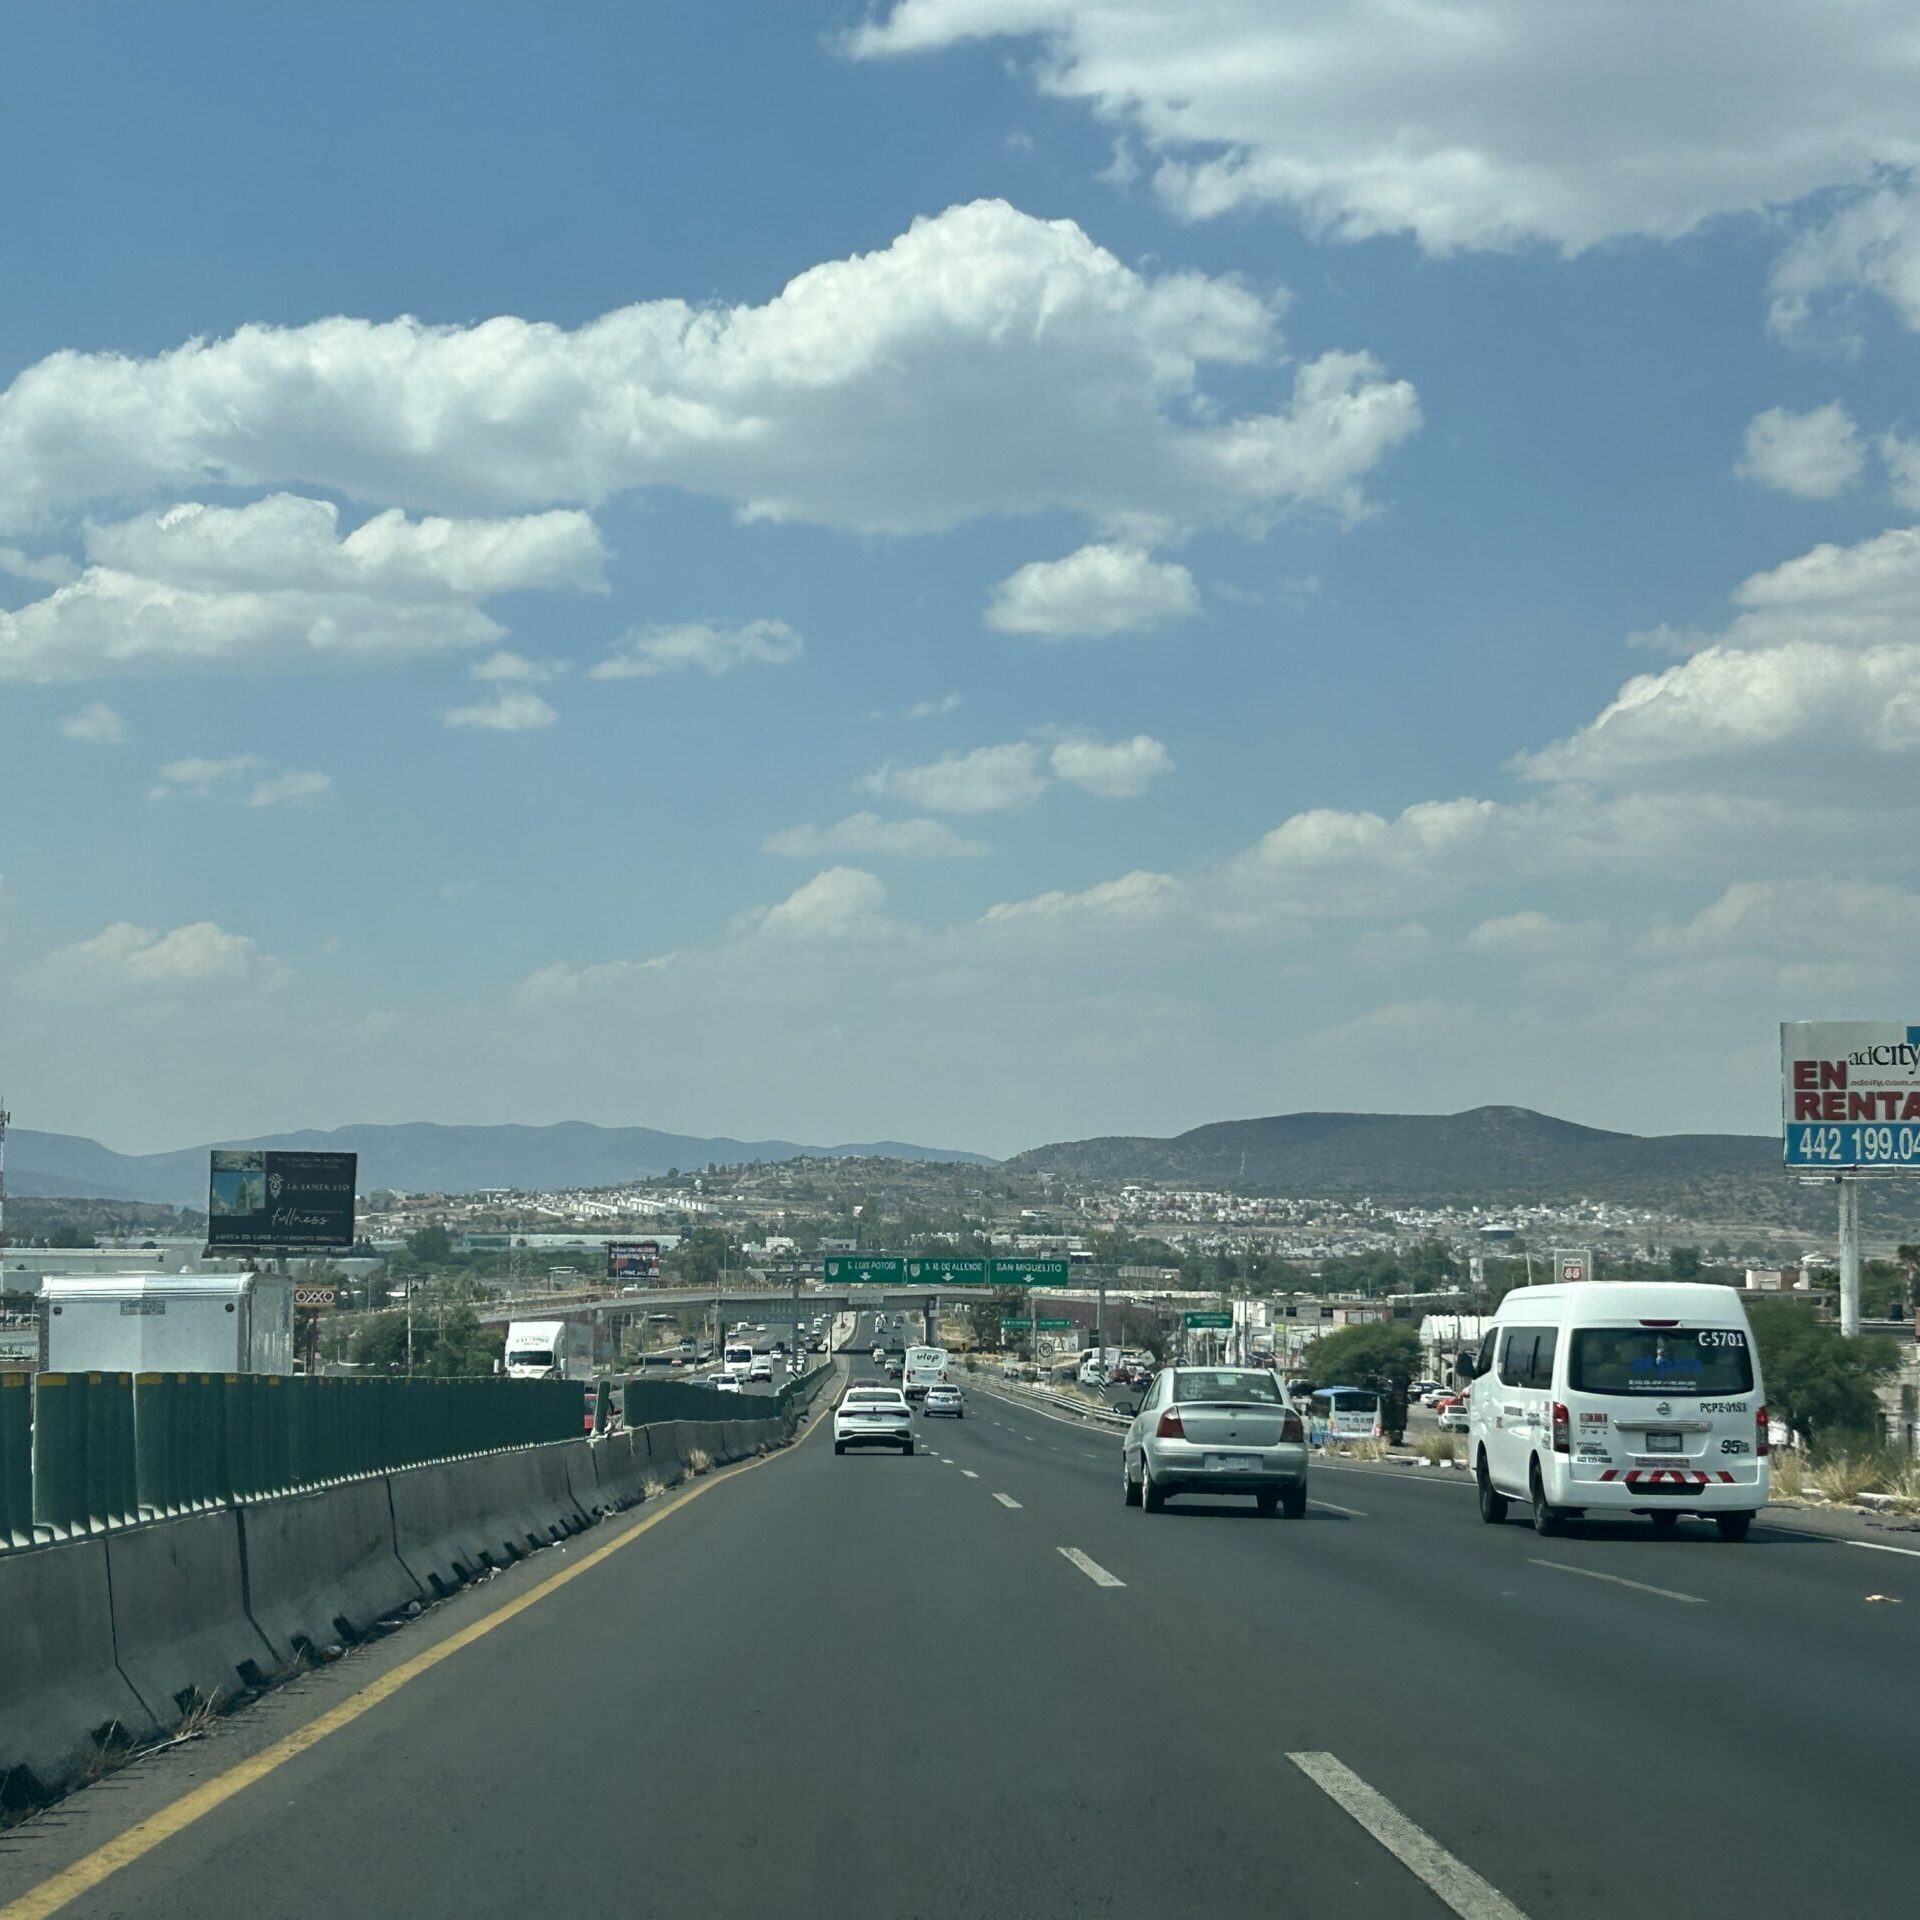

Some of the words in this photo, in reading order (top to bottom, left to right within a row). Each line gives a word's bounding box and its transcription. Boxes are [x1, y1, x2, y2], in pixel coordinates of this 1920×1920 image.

[1793, 1060, 1847, 1090] EN
[1794, 1091, 1920, 1121] RENTA
[1799, 1127, 1842, 1161] 442
[1851, 1127, 1920, 1161] 199.04
[855, 1261, 870, 1270] LUIS
[996, 1263, 1014, 1272] SAN
[1015, 1263, 1062, 1272] MIGUELITO
[295, 1290, 335, 1304] OXXO
[1698, 1331, 1744, 1347] C-5701
[1720, 1439, 1742, 1454] 95
